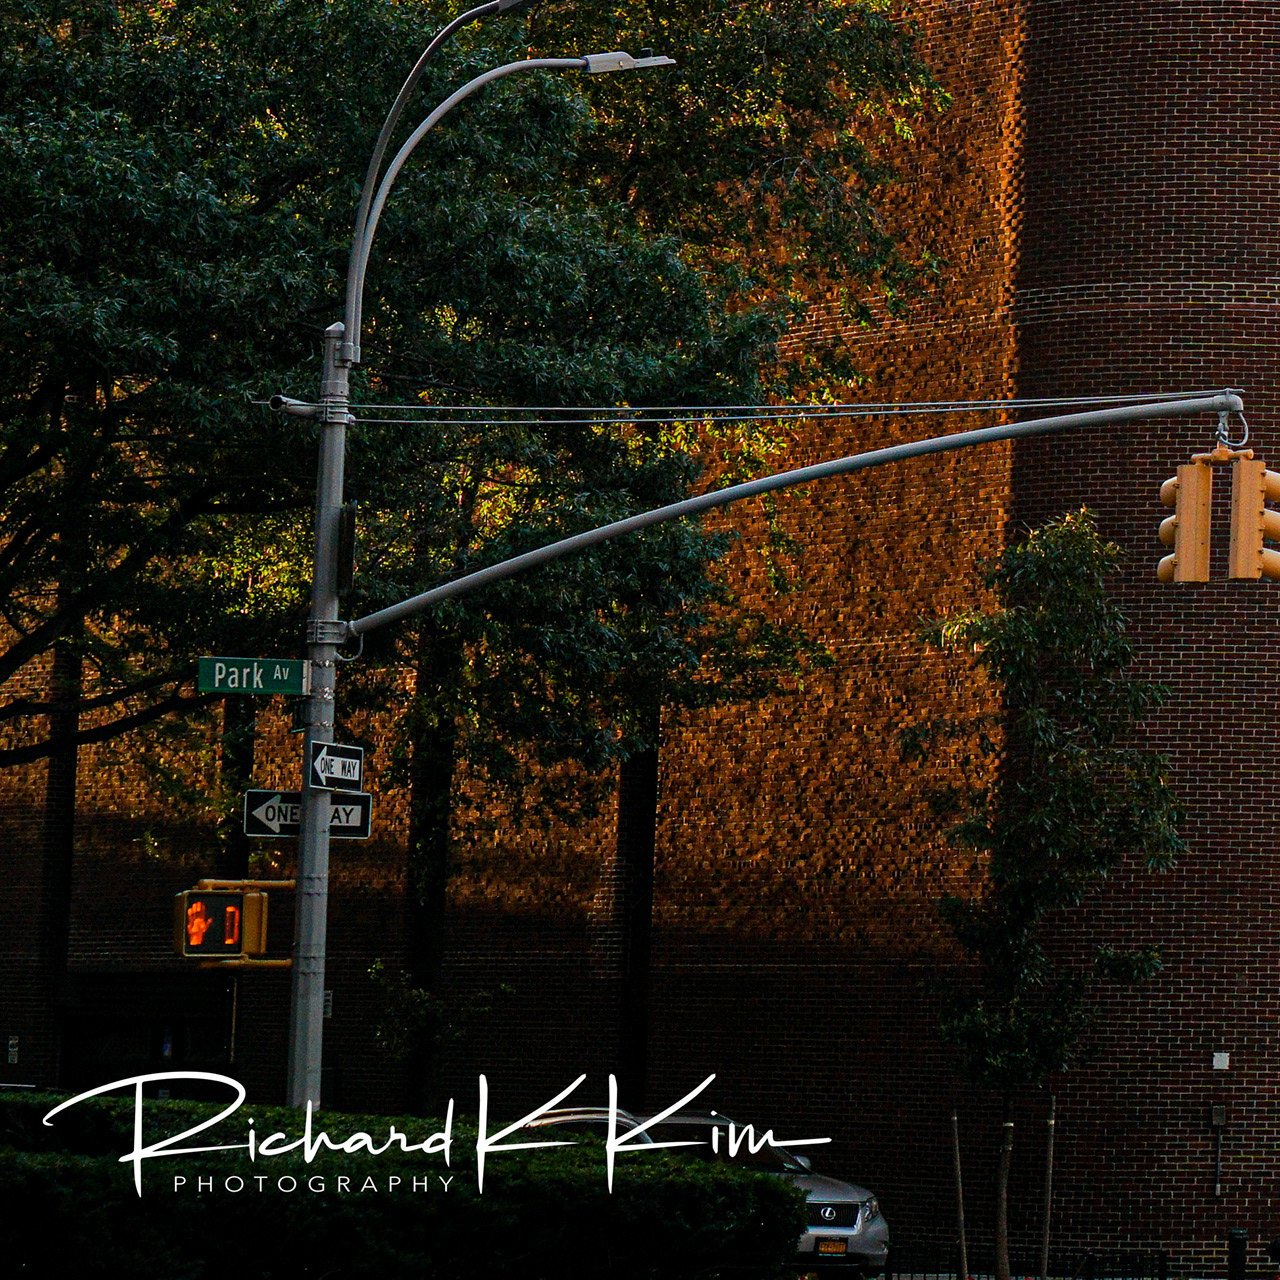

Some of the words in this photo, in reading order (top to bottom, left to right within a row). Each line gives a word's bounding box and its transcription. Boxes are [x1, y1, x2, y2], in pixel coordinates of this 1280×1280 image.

[214, 662, 264, 689] Park
[273, 664, 290, 681] Av
[319, 755, 335, 776] ONE
[340, 759, 357, 778] WAY
[264, 804, 300, 824] ONE
[329, 807, 354, 824] AY
